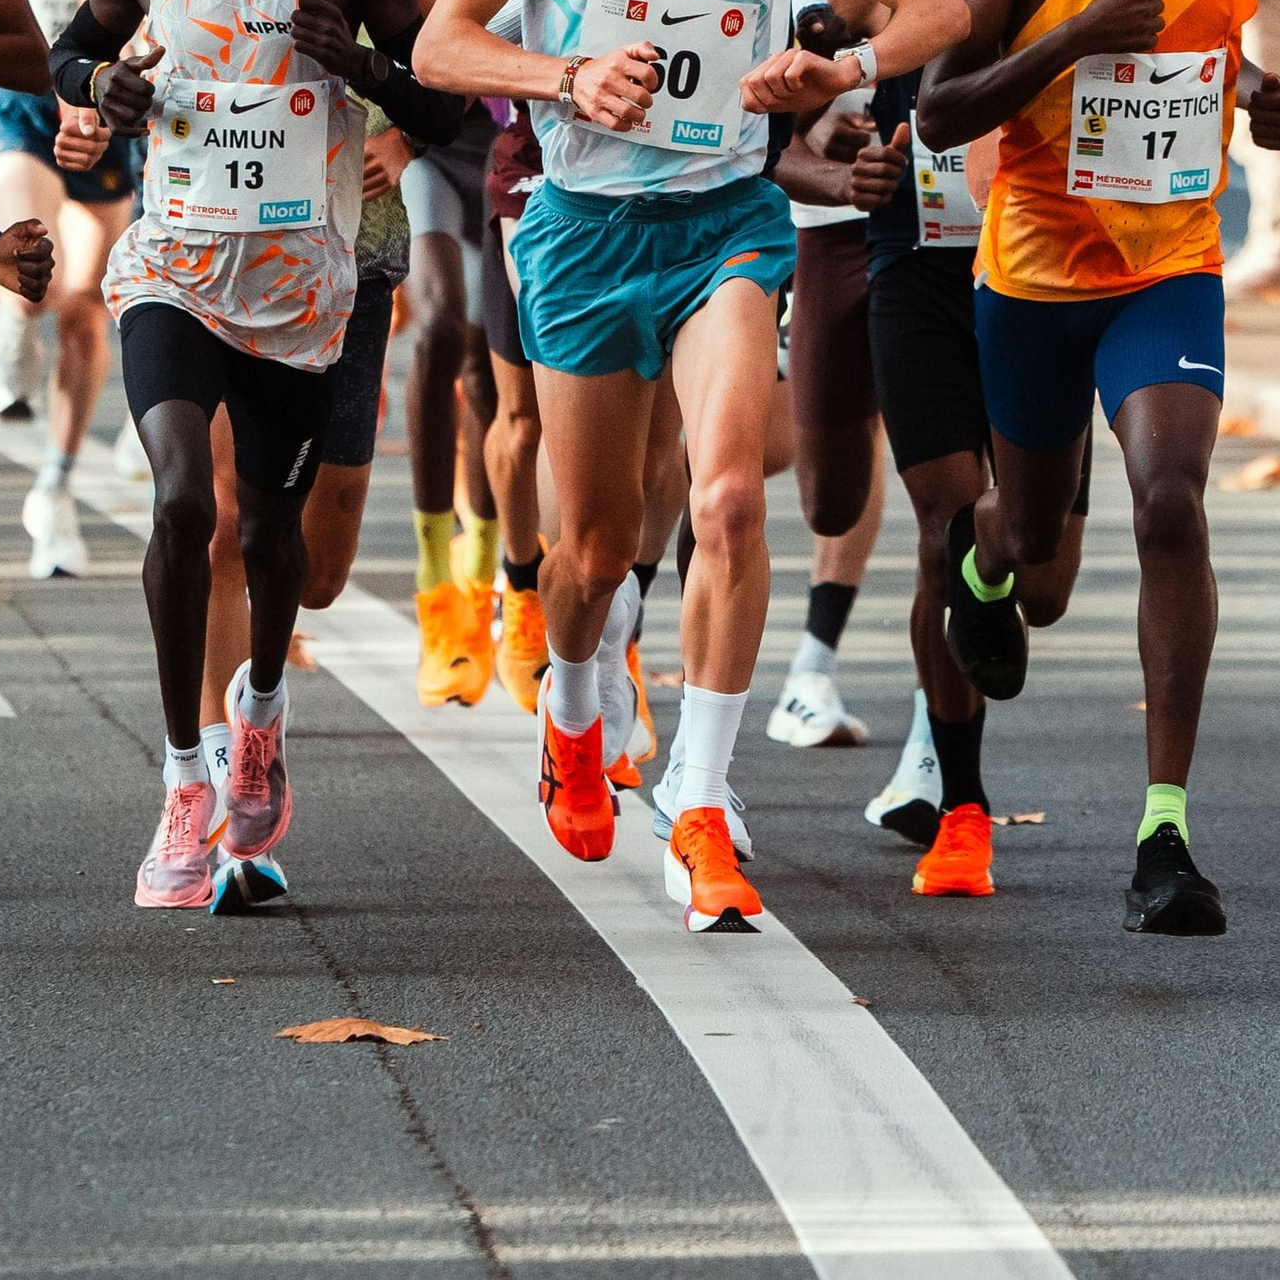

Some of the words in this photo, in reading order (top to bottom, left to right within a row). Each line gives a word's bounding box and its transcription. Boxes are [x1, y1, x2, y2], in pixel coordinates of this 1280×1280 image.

[175, 120, 187, 135] E
[676, 123, 720, 141] Nord
[1088, 118, 1103, 133] E
[204, 128, 285, 150] AIMUN
[1143, 131, 1177, 160] 17
[225, 161, 264, 190] 13
[922, 174, 930, 184] E
[1096, 175, 1152, 186] MÉTROPOLE
[1172, 170, 1207, 189] Nord
[262, 201, 308, 219] Nord
[283, 437, 313, 488] KIPRUN
